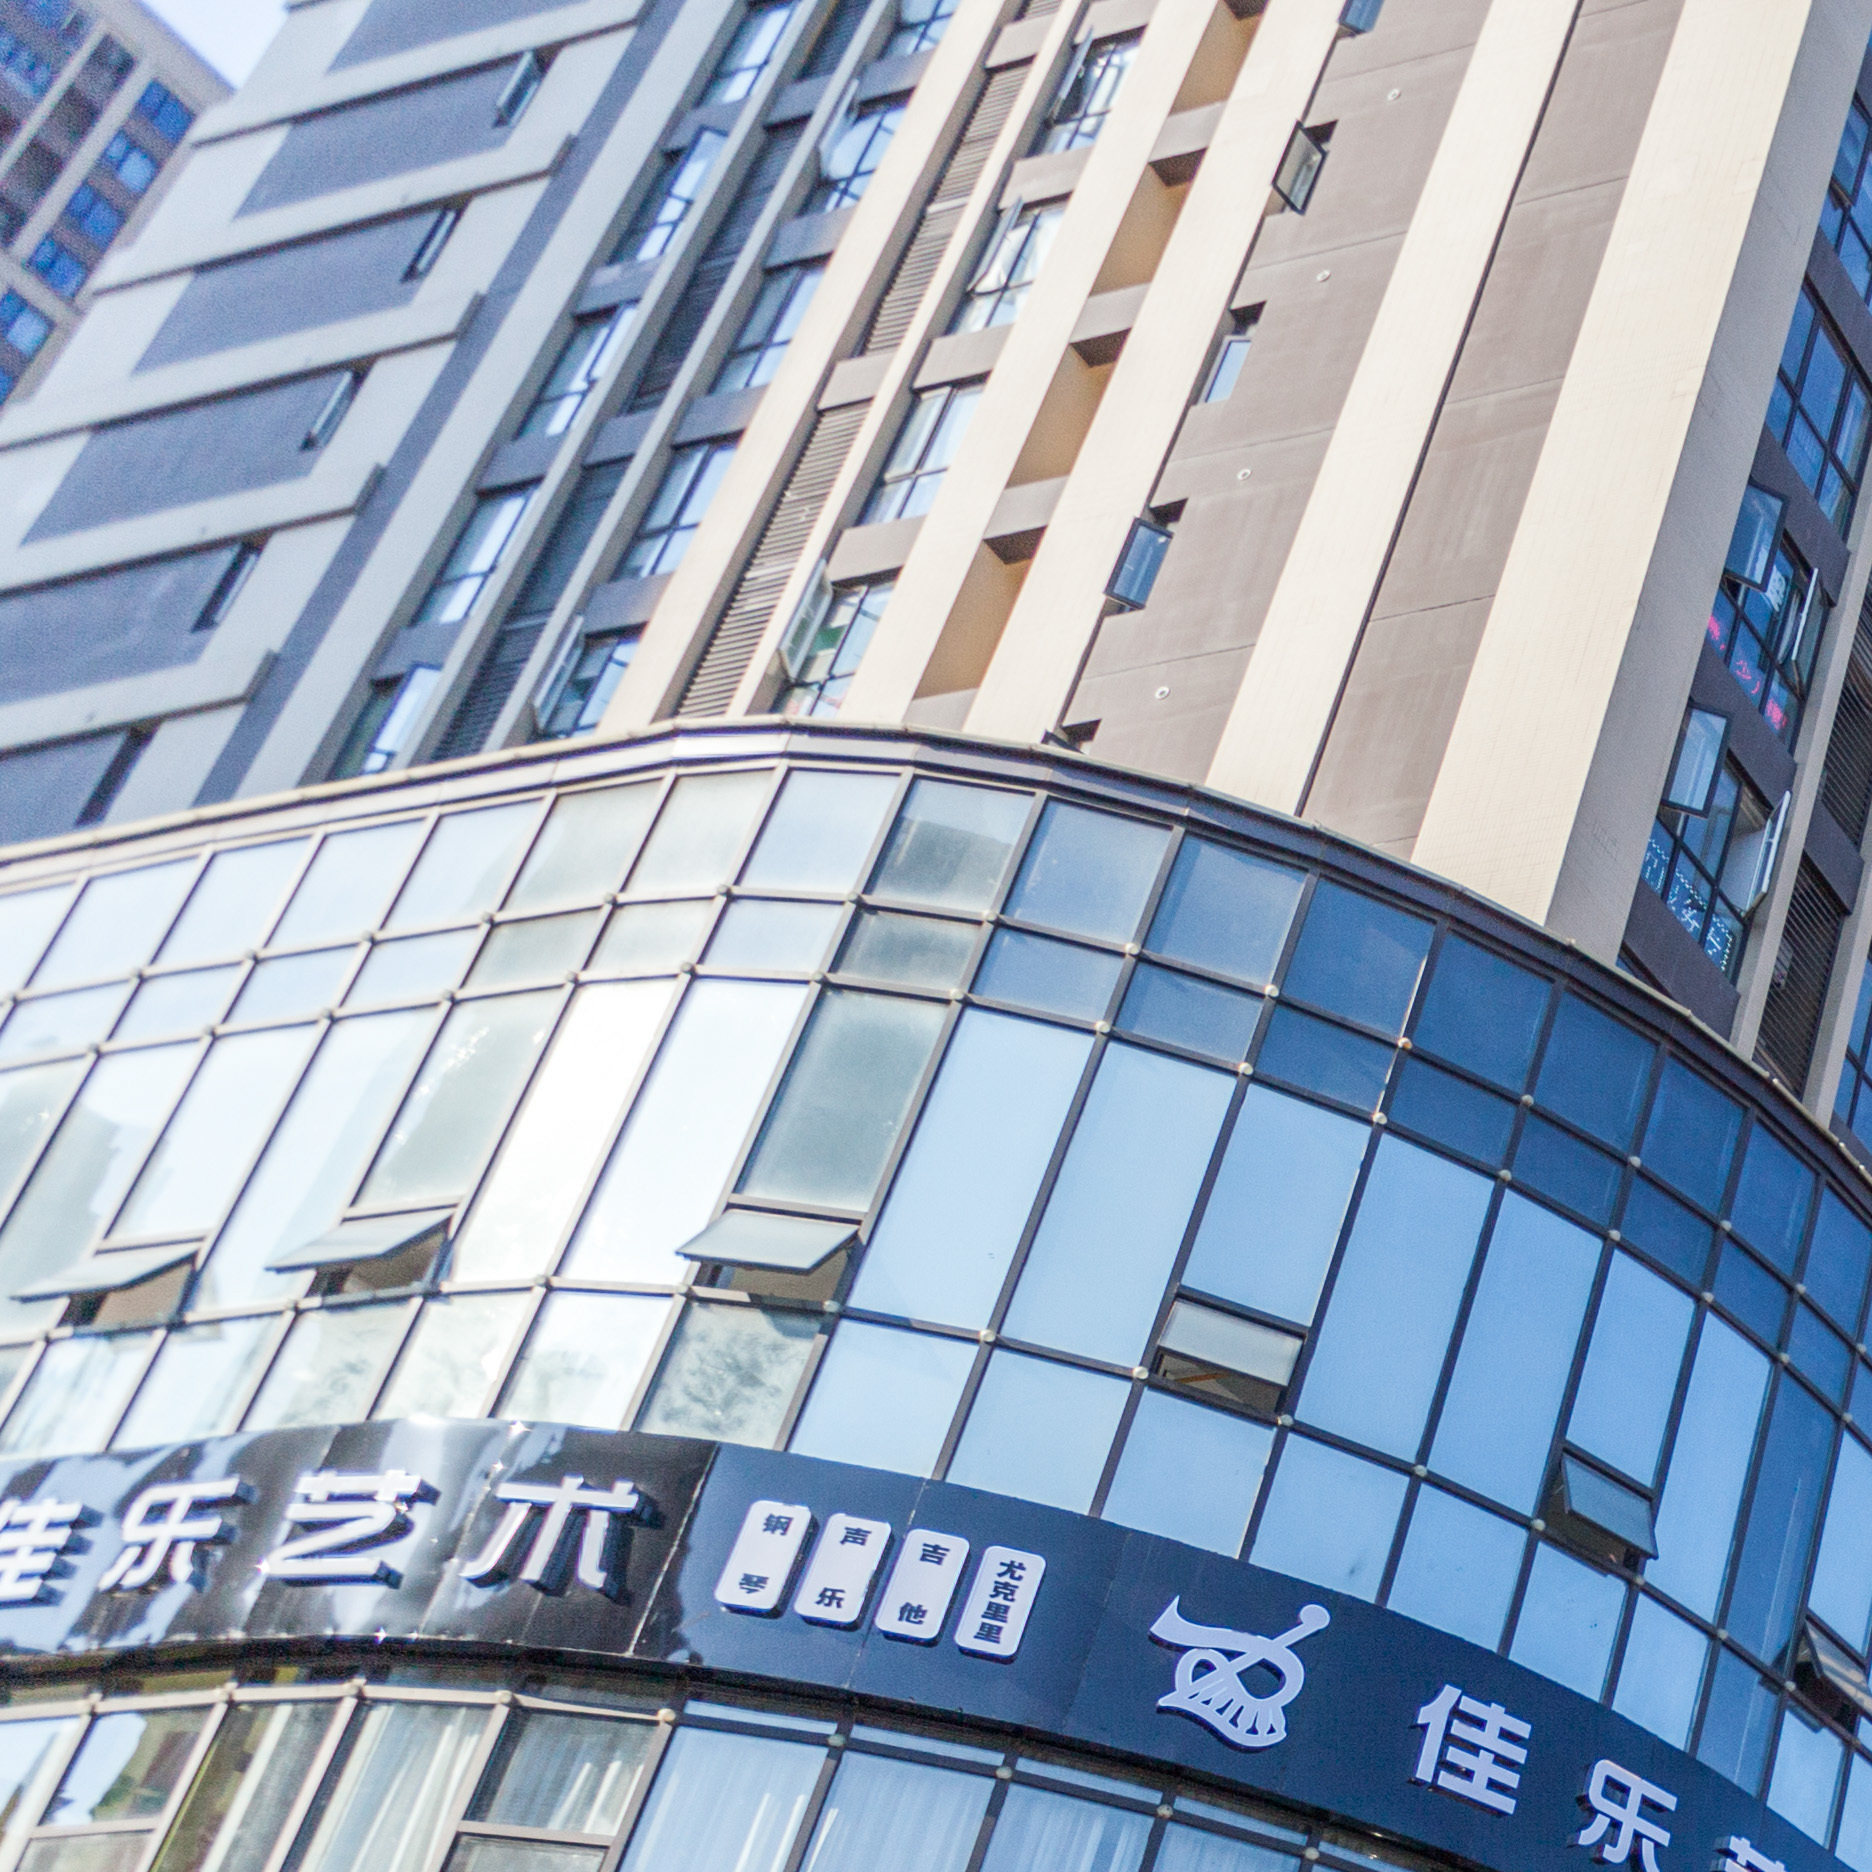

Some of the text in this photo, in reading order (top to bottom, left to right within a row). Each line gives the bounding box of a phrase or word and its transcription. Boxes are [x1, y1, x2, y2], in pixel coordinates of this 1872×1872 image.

[738, 1512, 792, 1595] 钢琴
[814, 1525, 873, 1610] 声乐
[897, 1541, 952, 1627] 吉他
[979, 1558, 1028, 1644] 尤克里里
